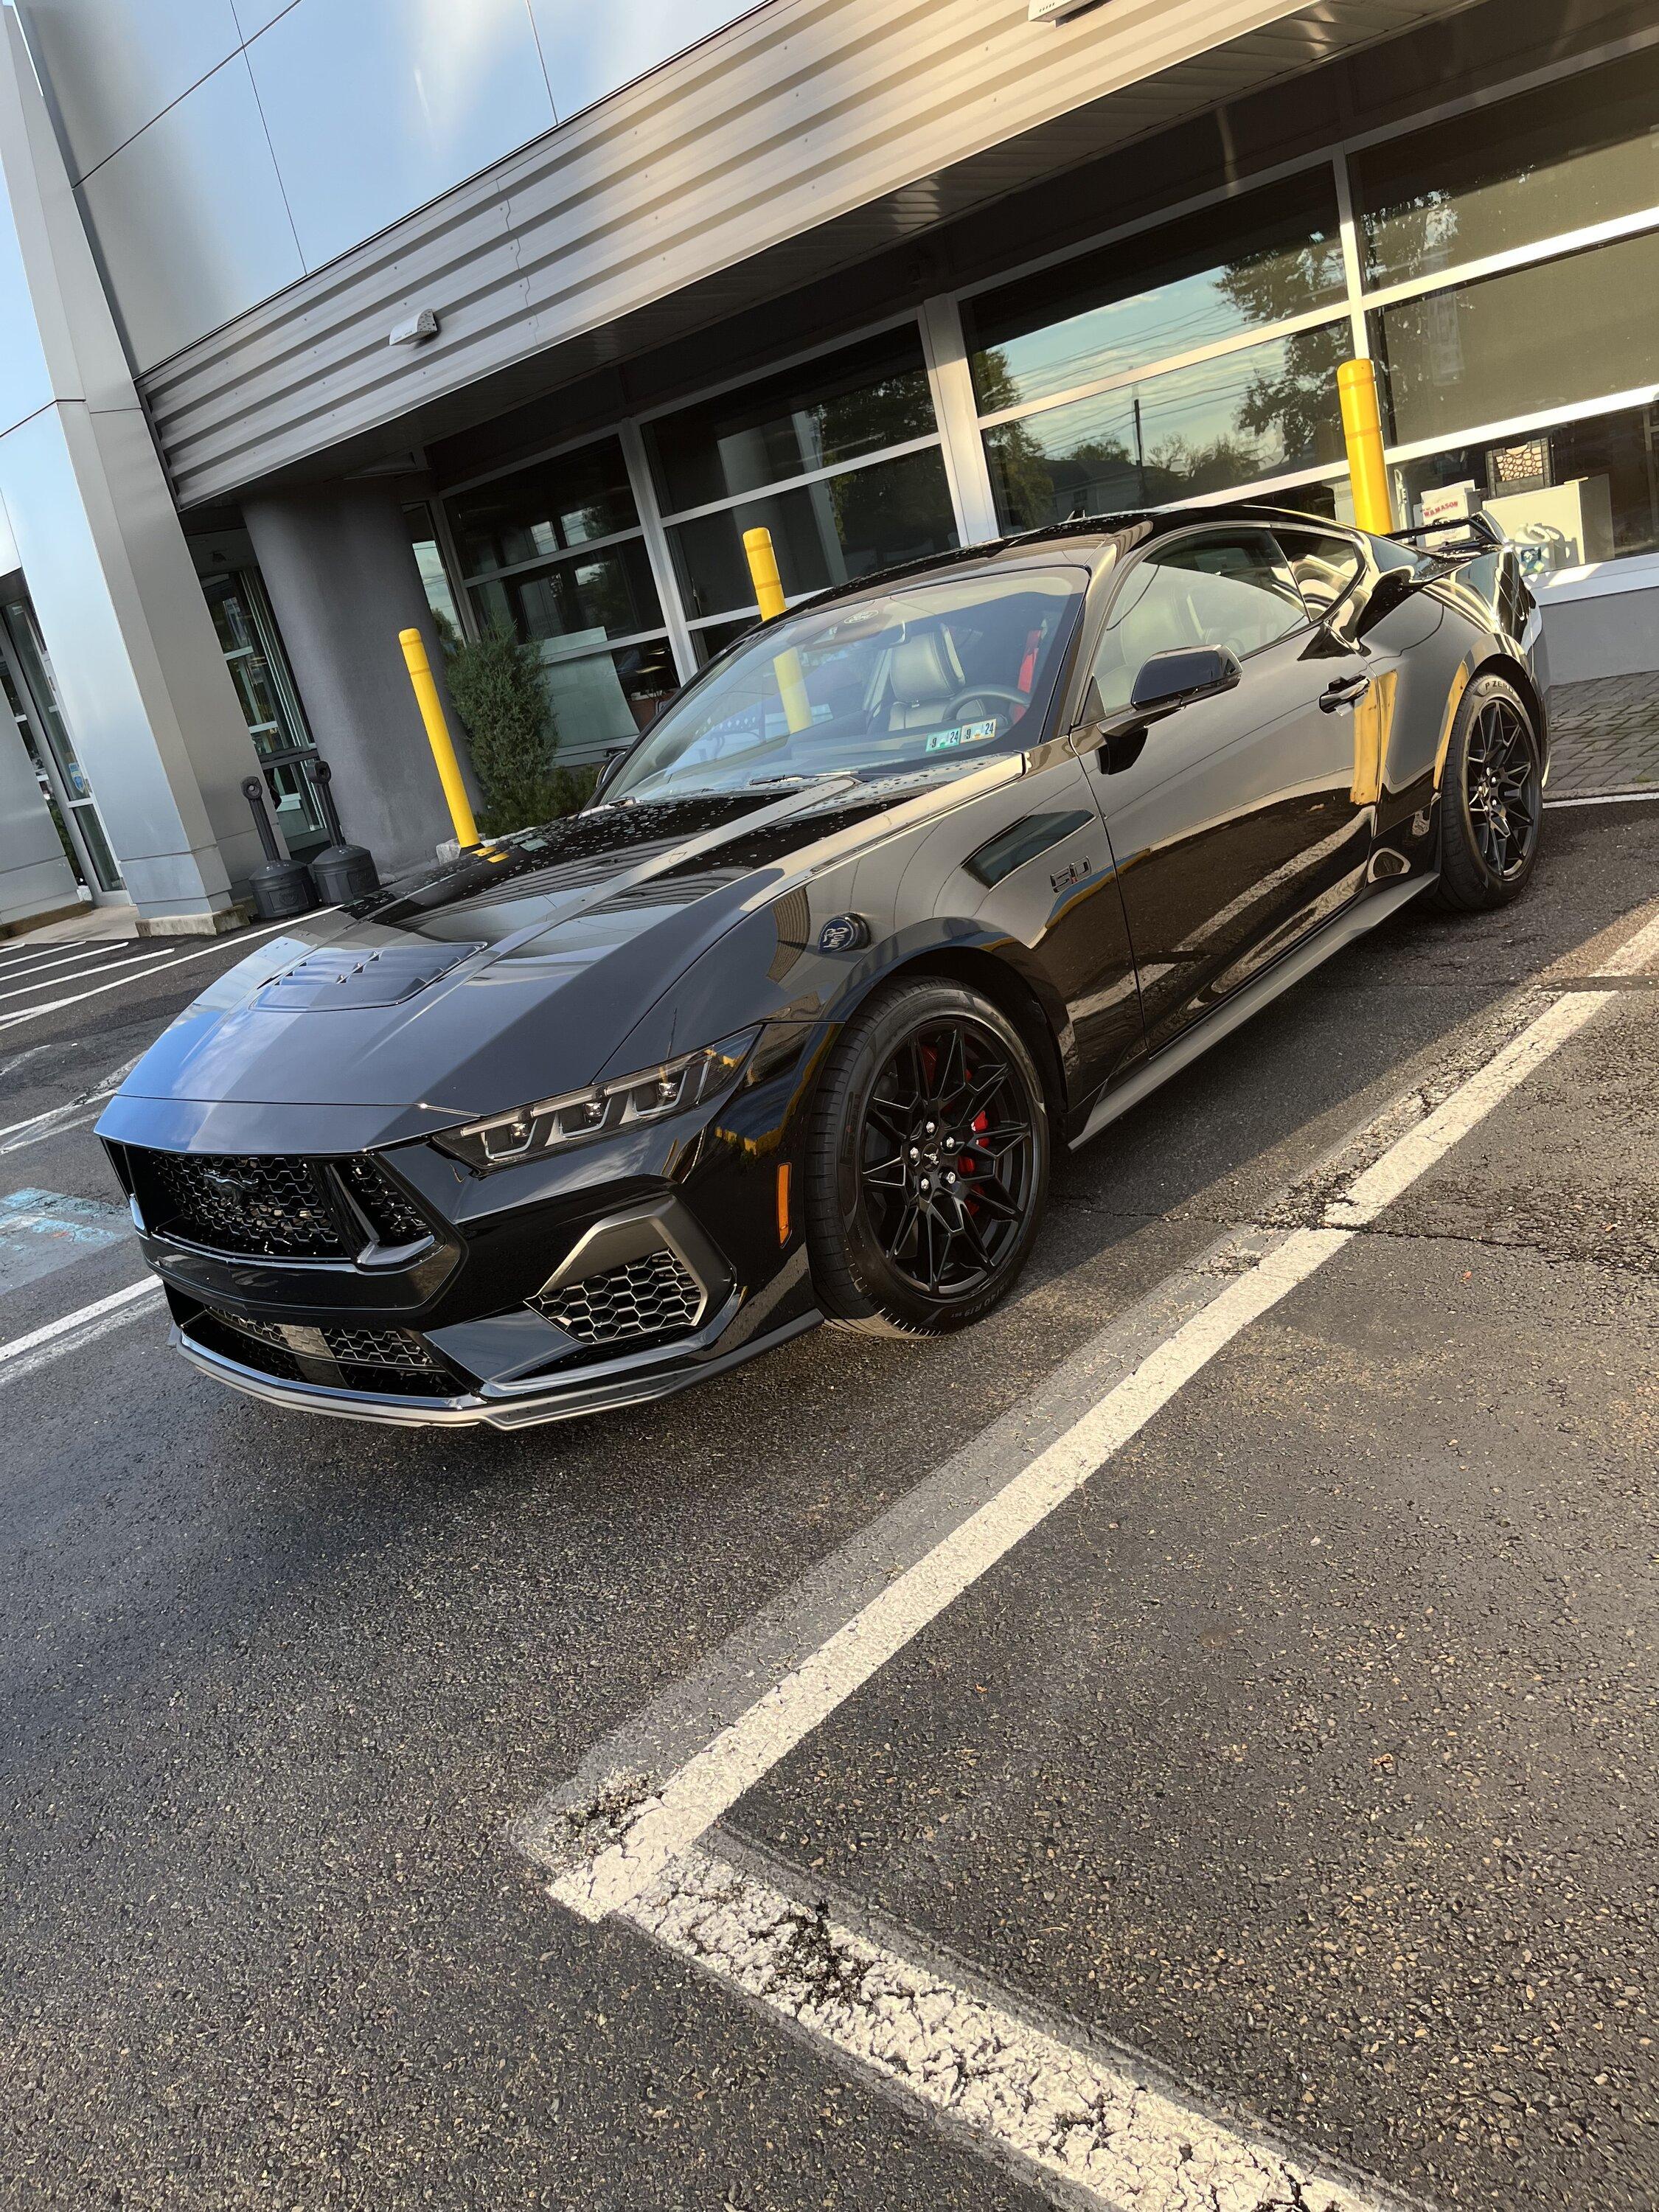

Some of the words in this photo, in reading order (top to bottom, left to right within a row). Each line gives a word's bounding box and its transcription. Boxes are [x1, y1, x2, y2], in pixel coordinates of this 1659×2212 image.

[931, 737, 937, 748] 9
[950, 731, 959, 743] 24
[965, 728, 972, 740] 9
[984, 722, 994, 735] 24
